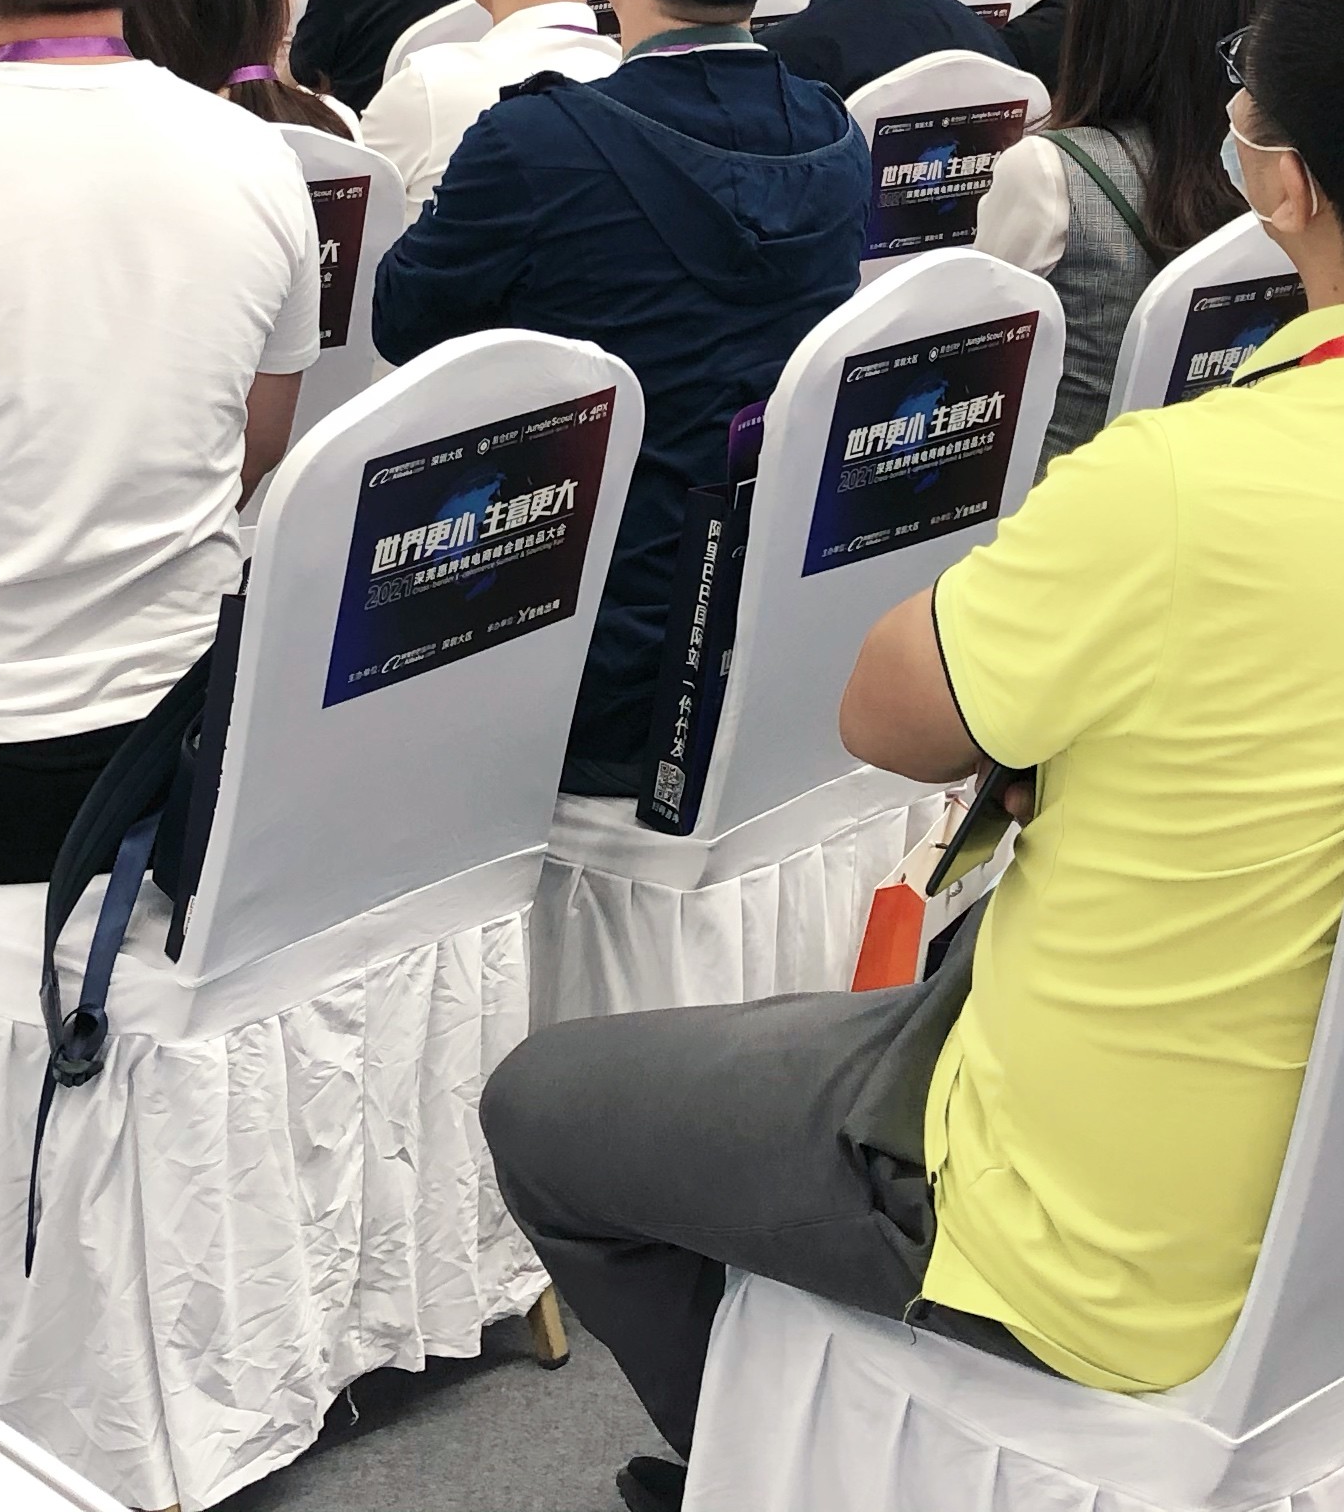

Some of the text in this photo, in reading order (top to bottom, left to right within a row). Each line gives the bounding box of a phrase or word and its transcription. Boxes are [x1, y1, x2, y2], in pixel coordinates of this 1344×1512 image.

[881, 159, 943, 187] 世界更小
[525, 420, 551, 434] Jungle
[551, 412, 574, 427] Scout
[843, 391, 1006, 461] 世界更小 生意更大
[371, 479, 579, 575] 世界更小 生意更大
[364, 573, 414, 610] 2021
